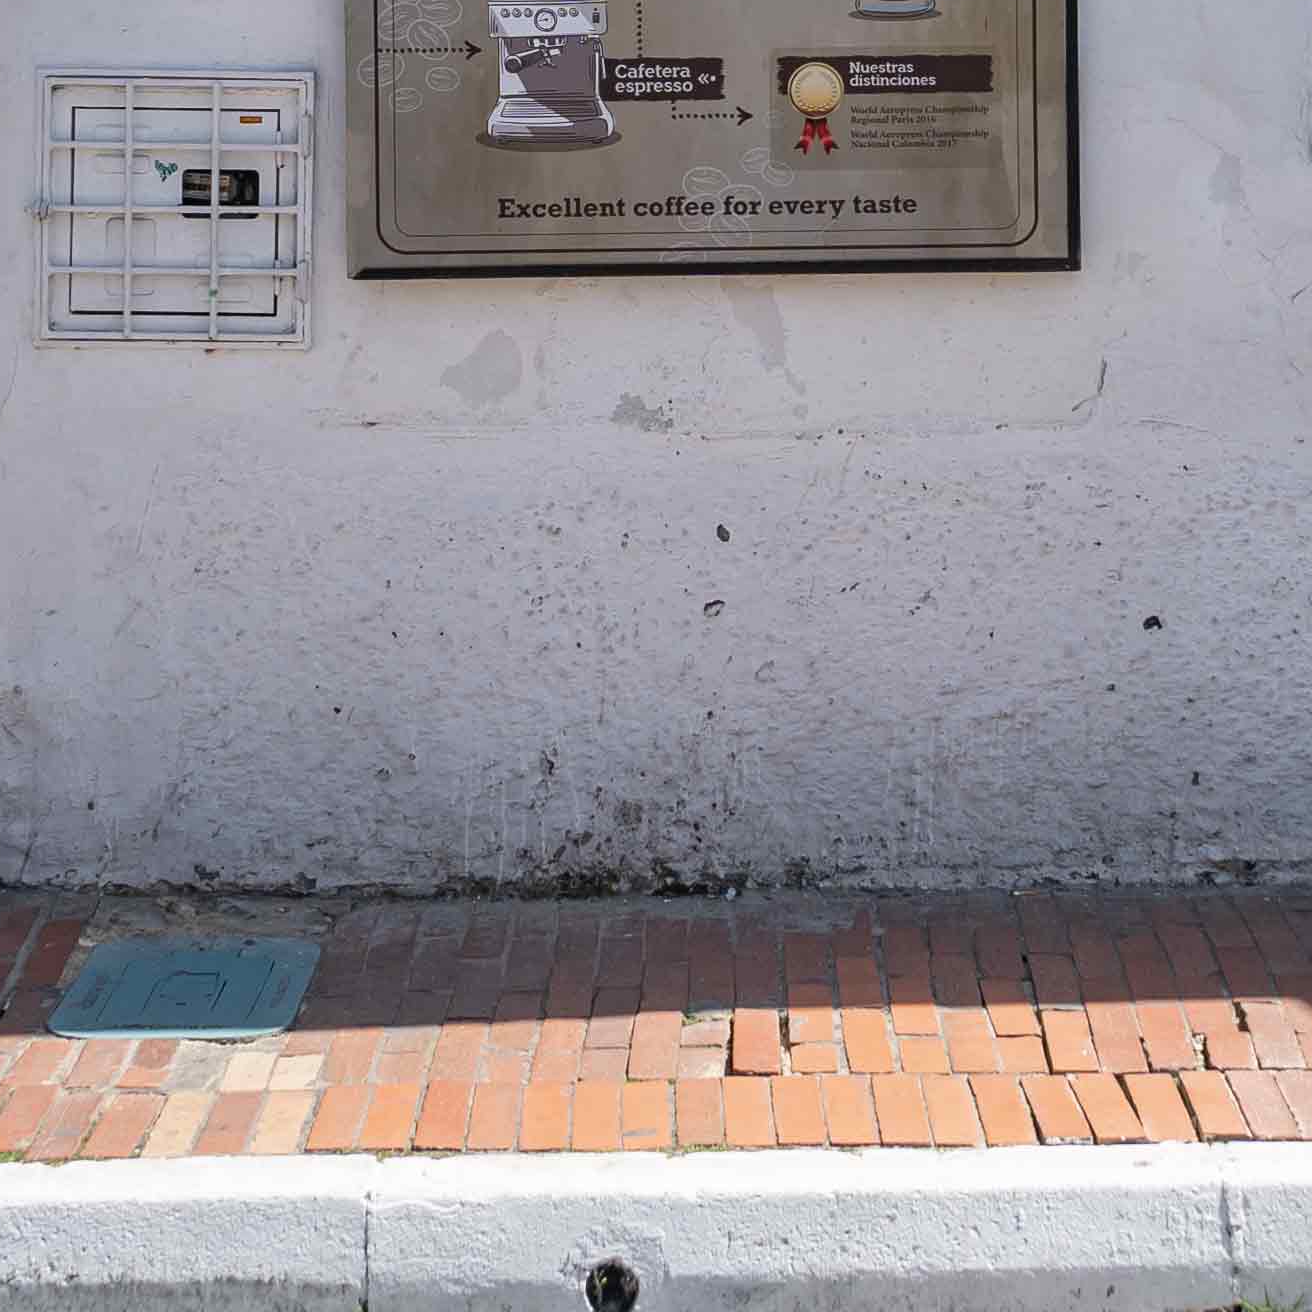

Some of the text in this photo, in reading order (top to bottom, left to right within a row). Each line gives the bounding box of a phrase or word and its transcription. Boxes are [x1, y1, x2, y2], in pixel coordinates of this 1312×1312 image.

[615, 64, 691, 79] Cafetera
[849, 62, 914, 74] Nuestras
[615, 80, 693, 96] espresso
[849, 74, 937, 87] distinciones
[497, 195, 918, 219] Excellent coffee for every taste
